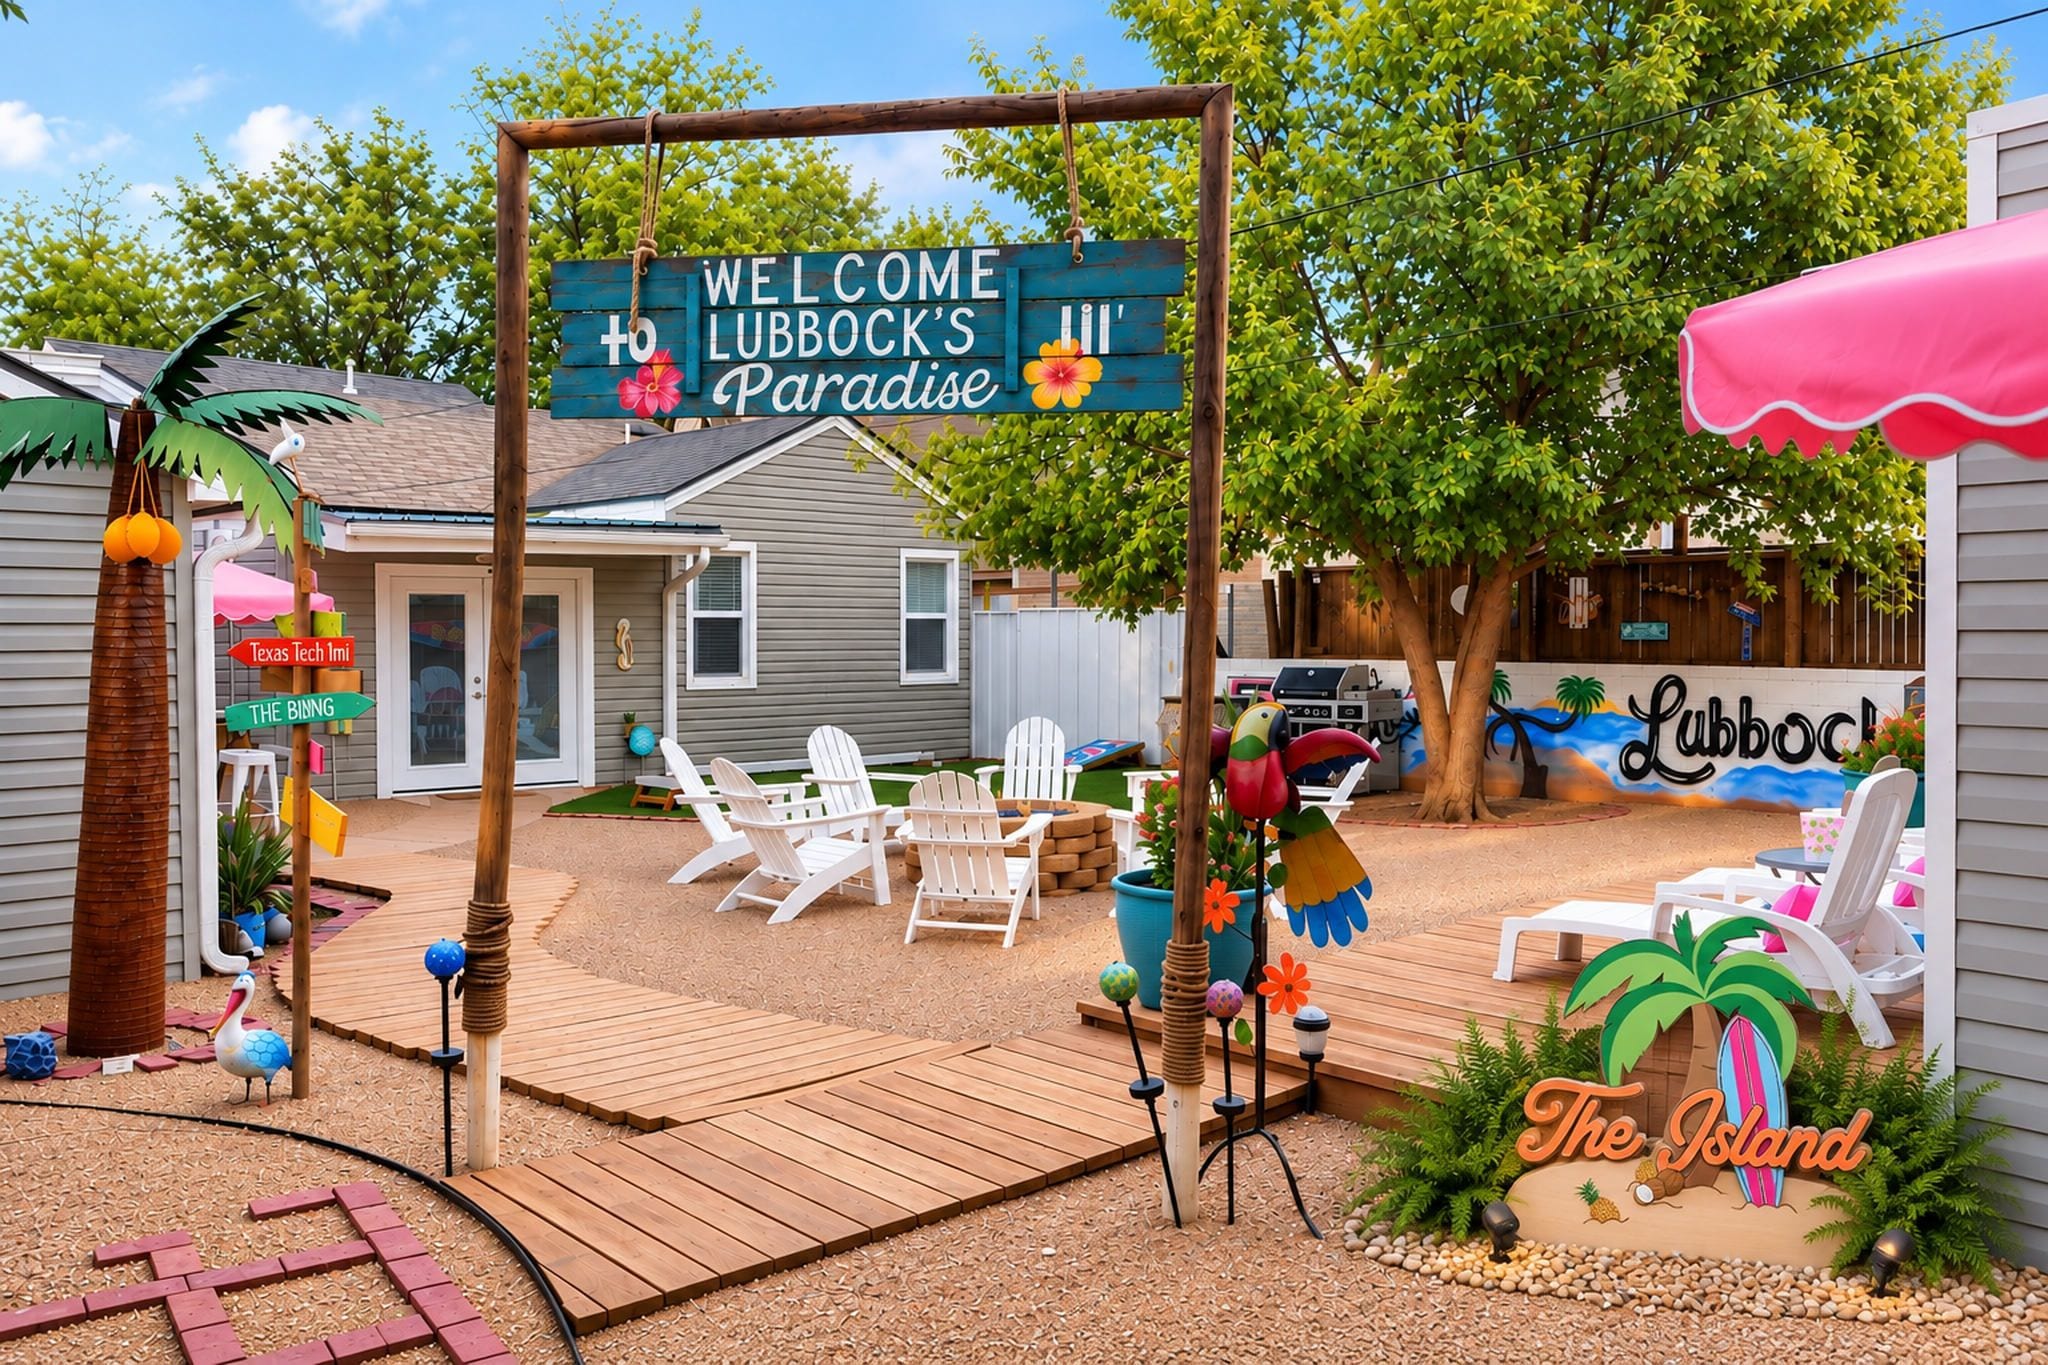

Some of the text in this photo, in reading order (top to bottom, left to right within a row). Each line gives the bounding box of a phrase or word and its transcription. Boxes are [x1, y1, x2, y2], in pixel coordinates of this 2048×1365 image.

[703, 248, 1000, 306] WELCOME
[600, 314, 657, 366] to
[709, 306, 976, 361] LUBBOCK'S
[712, 360, 1000, 417] Paradise
[249, 641, 350, 662] Texas Tech 1mi
[248, 702, 282, 725] THE
[1516, 1077, 1872, 1174] The Island
